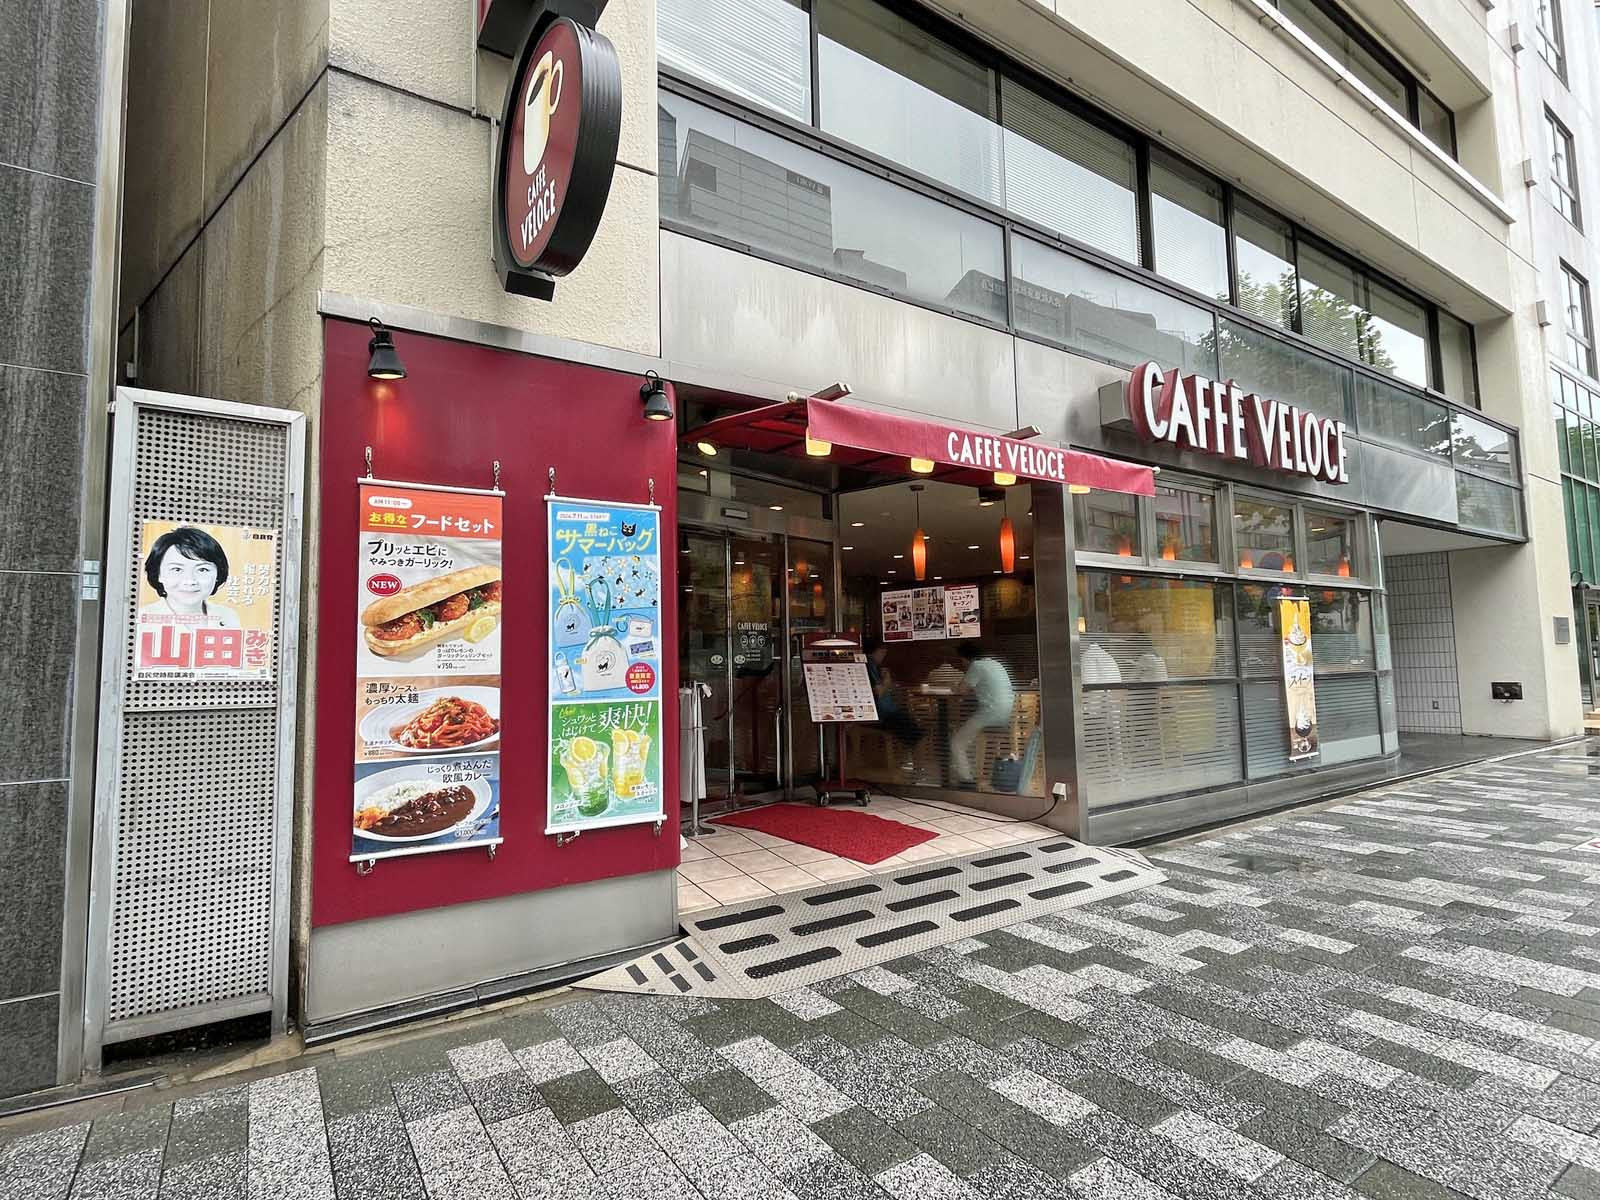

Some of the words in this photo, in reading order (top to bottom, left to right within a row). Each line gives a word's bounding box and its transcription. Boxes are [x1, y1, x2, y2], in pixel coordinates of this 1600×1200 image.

[520, 178, 556, 251] VELOCE
[1253, 394, 1349, 484] VELOCE
[1005, 441, 1065, 480] VELOCE
[369, 511, 407, 525] お得な
[410, 514, 495, 534] フードセット
[368, 539, 447, 556] プリッとエビに
[556, 528, 655, 554] サマーバッグ
[371, 580, 398, 589] NEW
[140, 625, 242, 667] 山田
[366, 683, 417, 693] 濃厚ソースと
[366, 693, 419, 705] もっちり太麺
[561, 713, 597, 727] シュワッと
[598, 702, 653, 733] 爽快!
[561, 723, 597, 737] はじけて
[427, 759, 492, 774] じっくり煮込んだ
[442, 773, 491, 783] 欧風カレー
